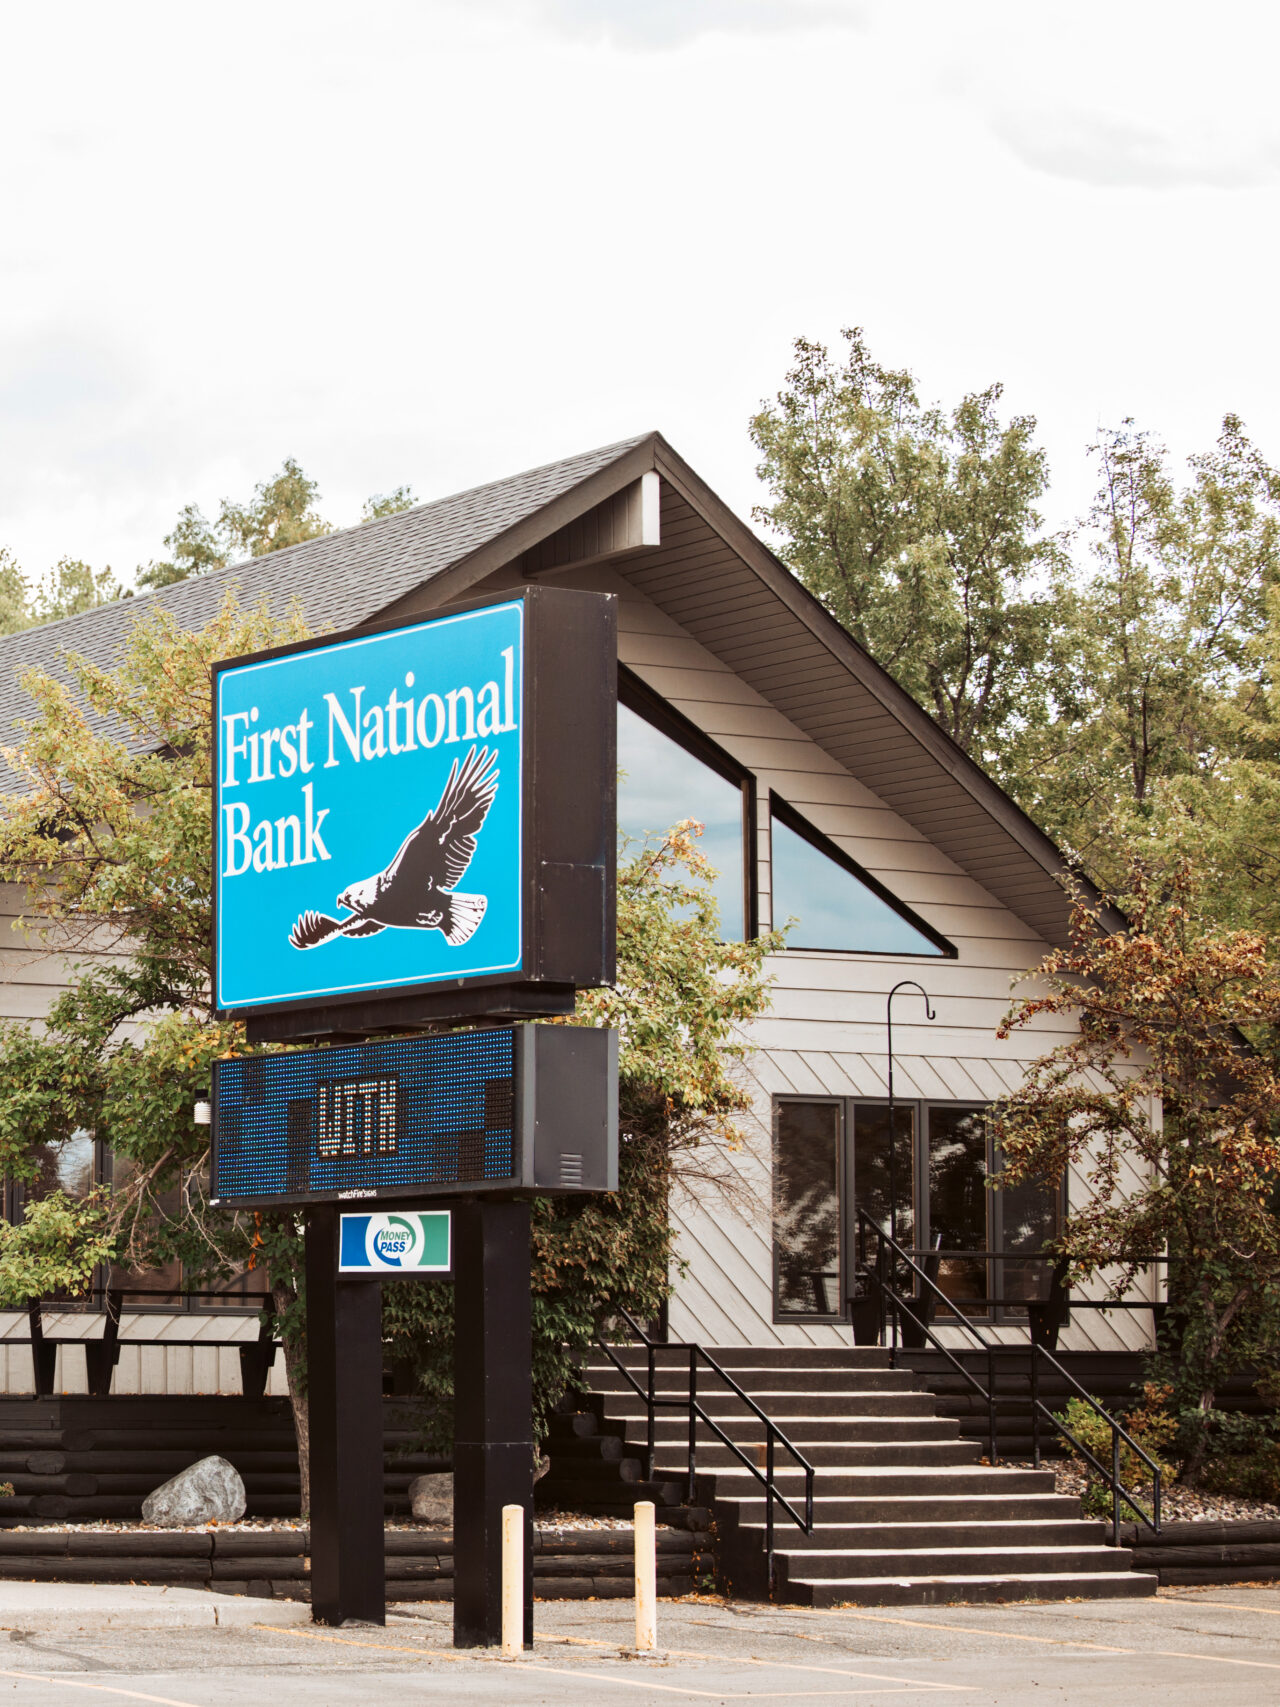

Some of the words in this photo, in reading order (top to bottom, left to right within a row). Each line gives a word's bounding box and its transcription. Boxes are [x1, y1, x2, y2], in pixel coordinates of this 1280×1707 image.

[222, 706, 315, 788] First
[323, 645, 518, 769] National
[222, 782, 332, 877] Bank
[380, 1231, 411, 1241] MONEY
[380, 1241, 406, 1253] PASS
